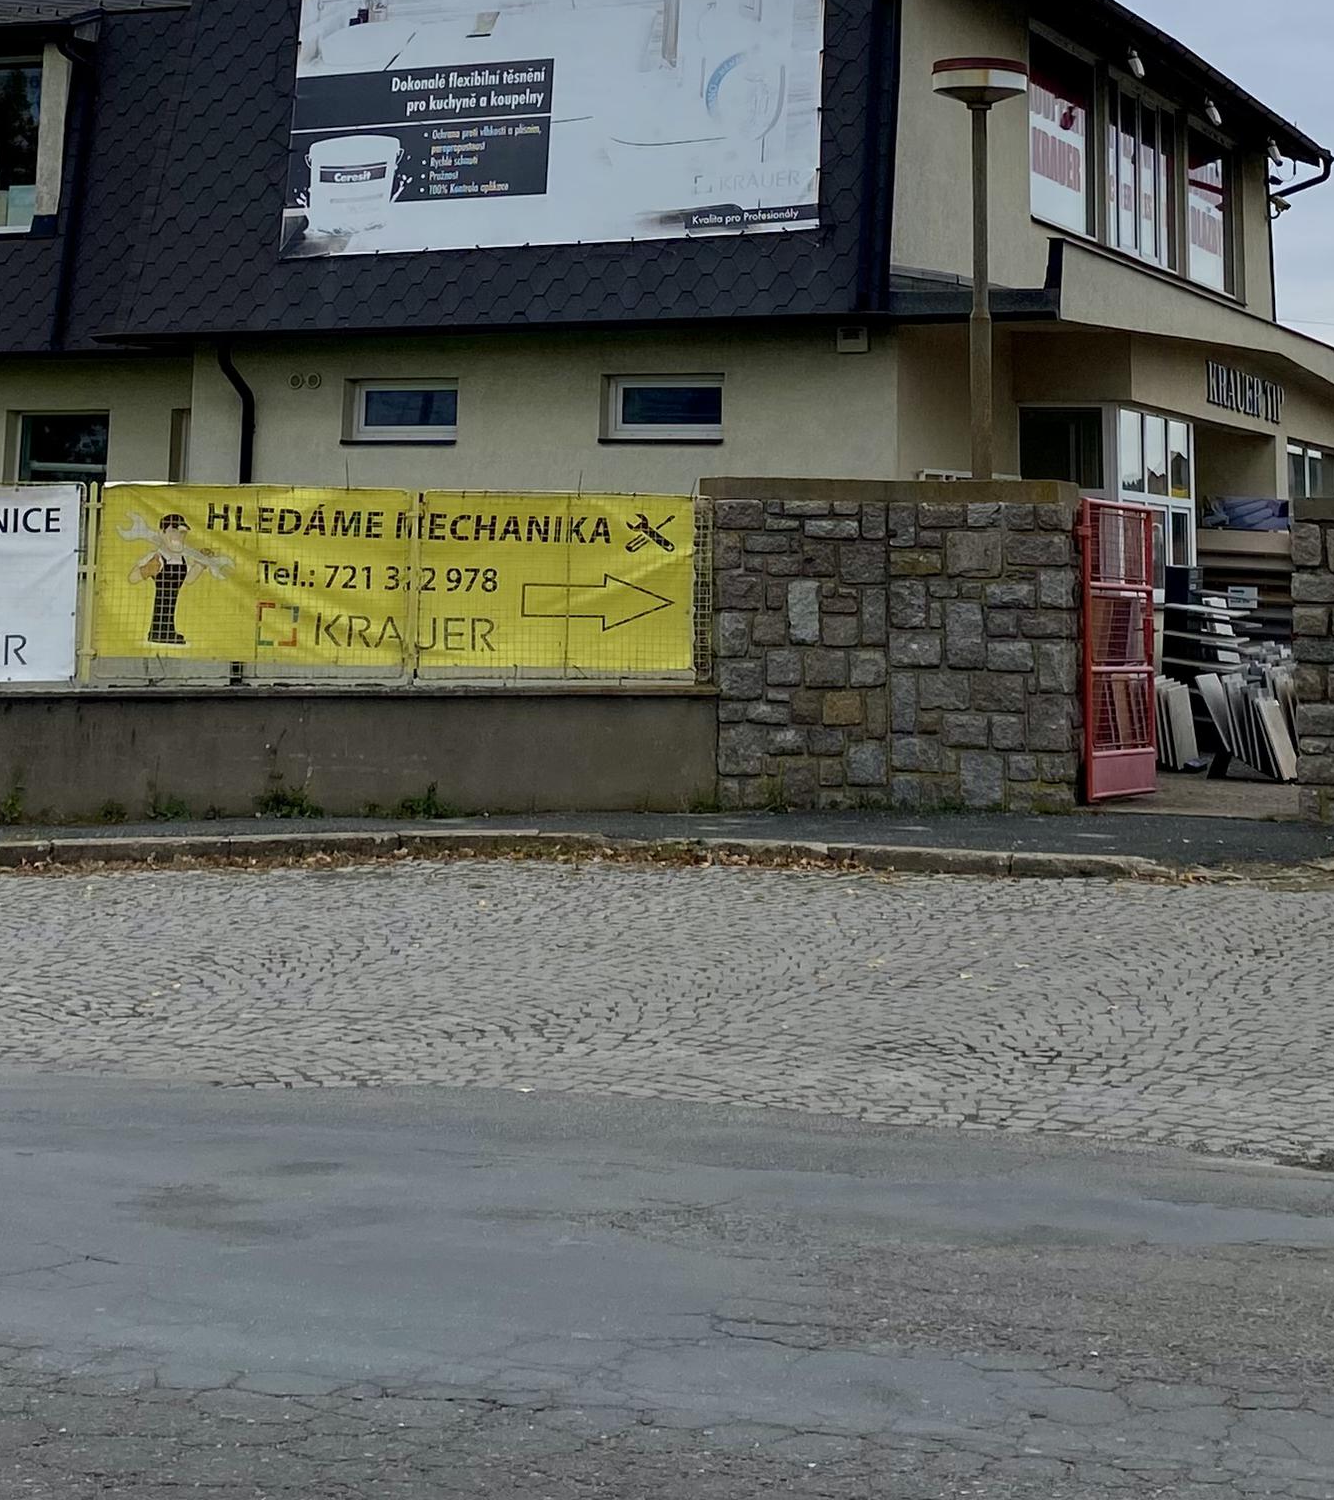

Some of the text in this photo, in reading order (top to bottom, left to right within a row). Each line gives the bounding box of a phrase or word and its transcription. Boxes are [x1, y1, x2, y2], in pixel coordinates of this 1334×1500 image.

[391, 66, 546, 92] Dokonalé flexibilní těsnění
[406, 88, 544, 116] pro kuchyně a koupelny
[334, 171, 372, 182] Ceresit
[429, 184, 448, 195] 100%
[719, 170, 800, 191] KRAUER
[692, 208, 799, 225] Kvalita pro Profesionály
[207, 502, 612, 544] HLEDÁME MECHANIKA
[259, 560, 315, 588] Tel.:
[324, 564, 372, 590] 721
[446, 567, 499, 593] 978
[314, 612, 497, 652] KRAUER
